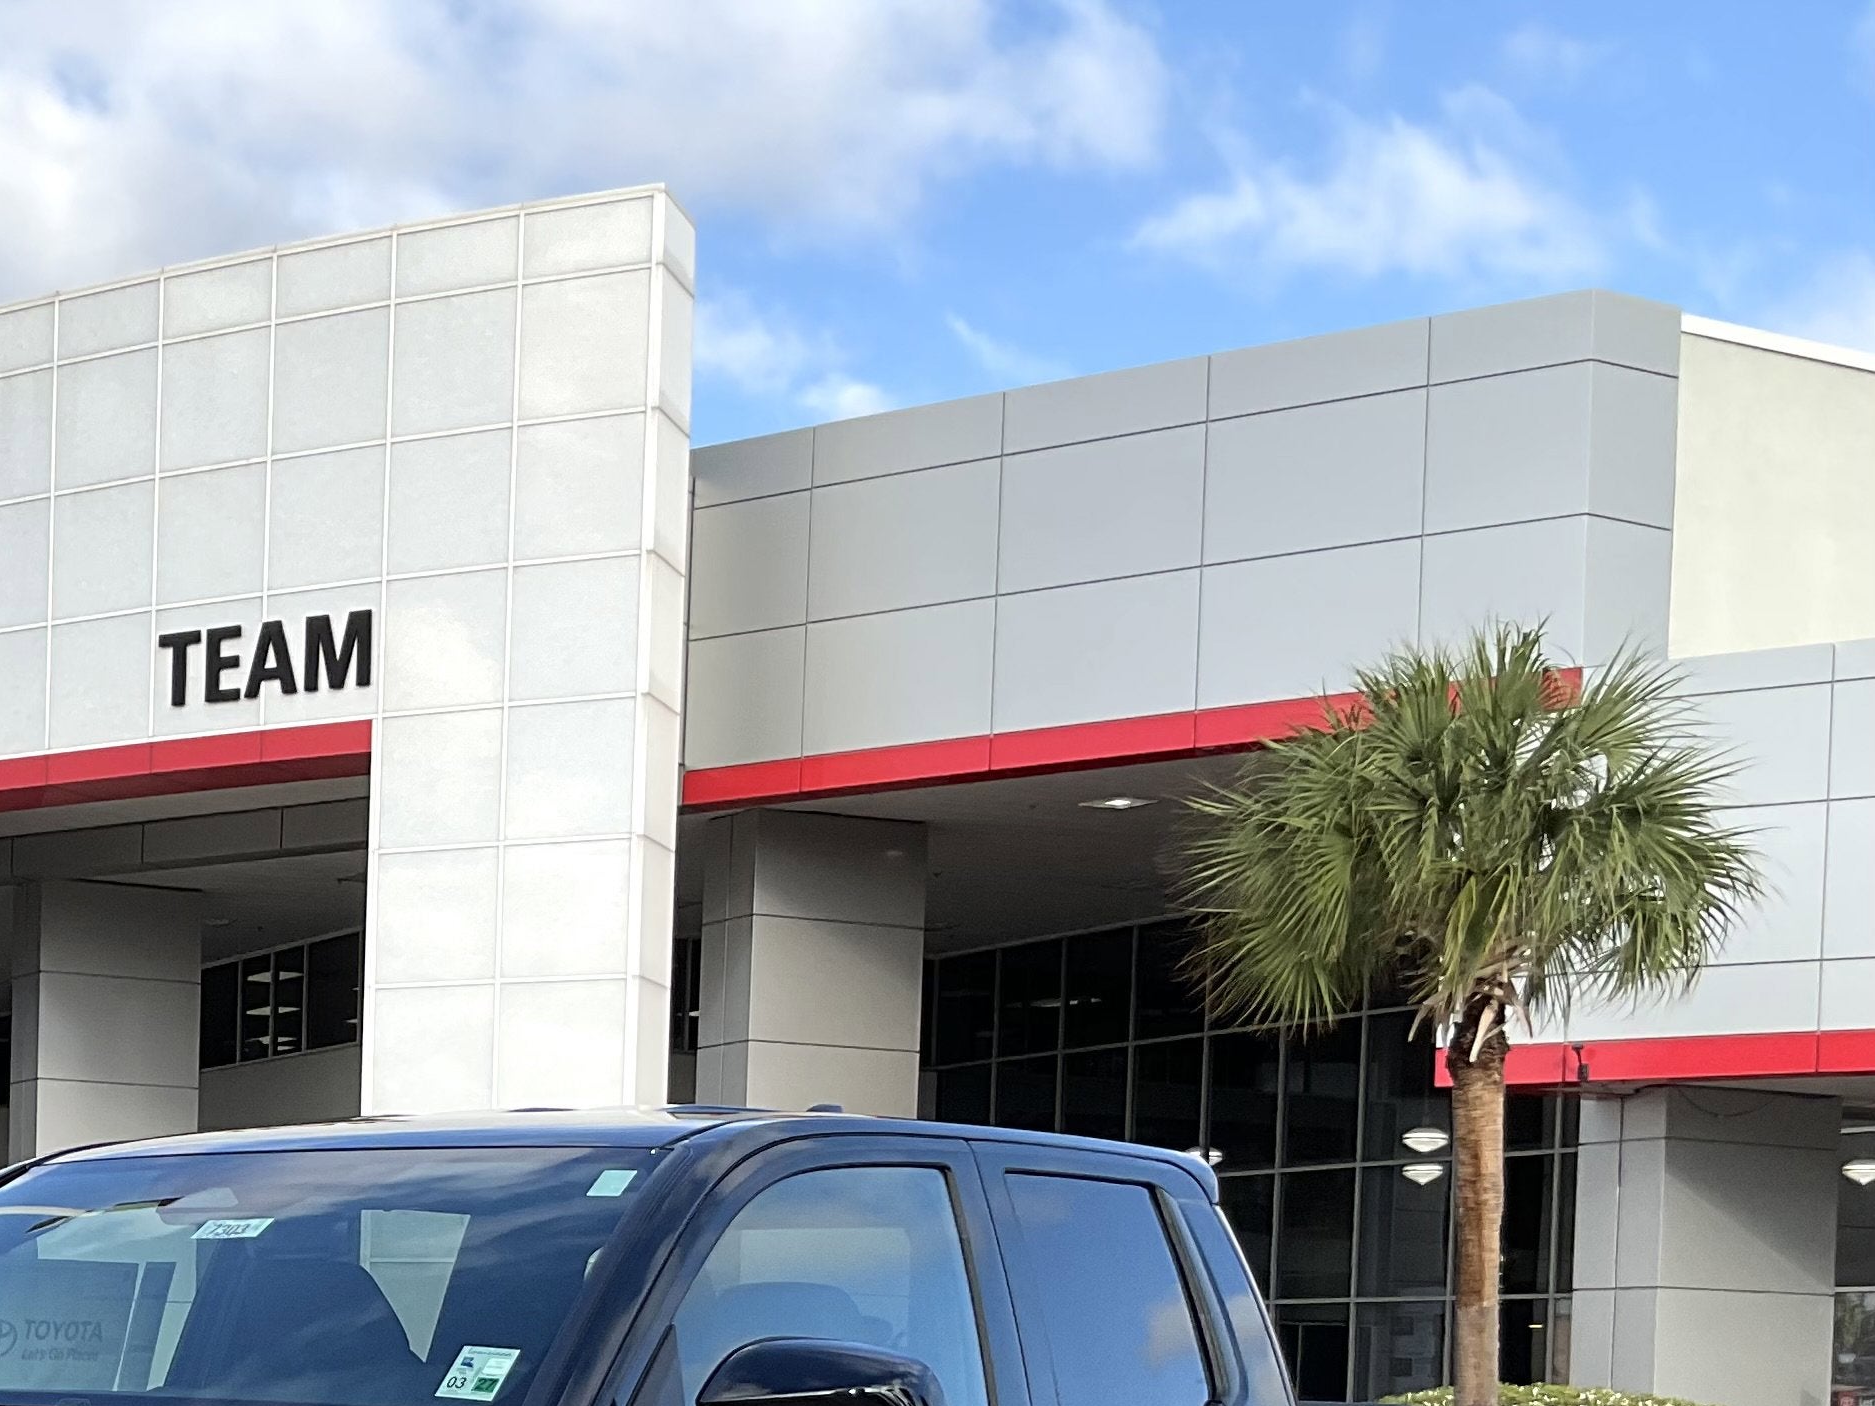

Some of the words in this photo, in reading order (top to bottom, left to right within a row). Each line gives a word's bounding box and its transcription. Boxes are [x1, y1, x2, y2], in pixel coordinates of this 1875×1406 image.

[158, 609, 373, 707] TEAM
[24, 1318, 103, 1342] TOYOTA
[446, 1376, 467, 1389] 03
[474, 1378, 497, 1391] 27
